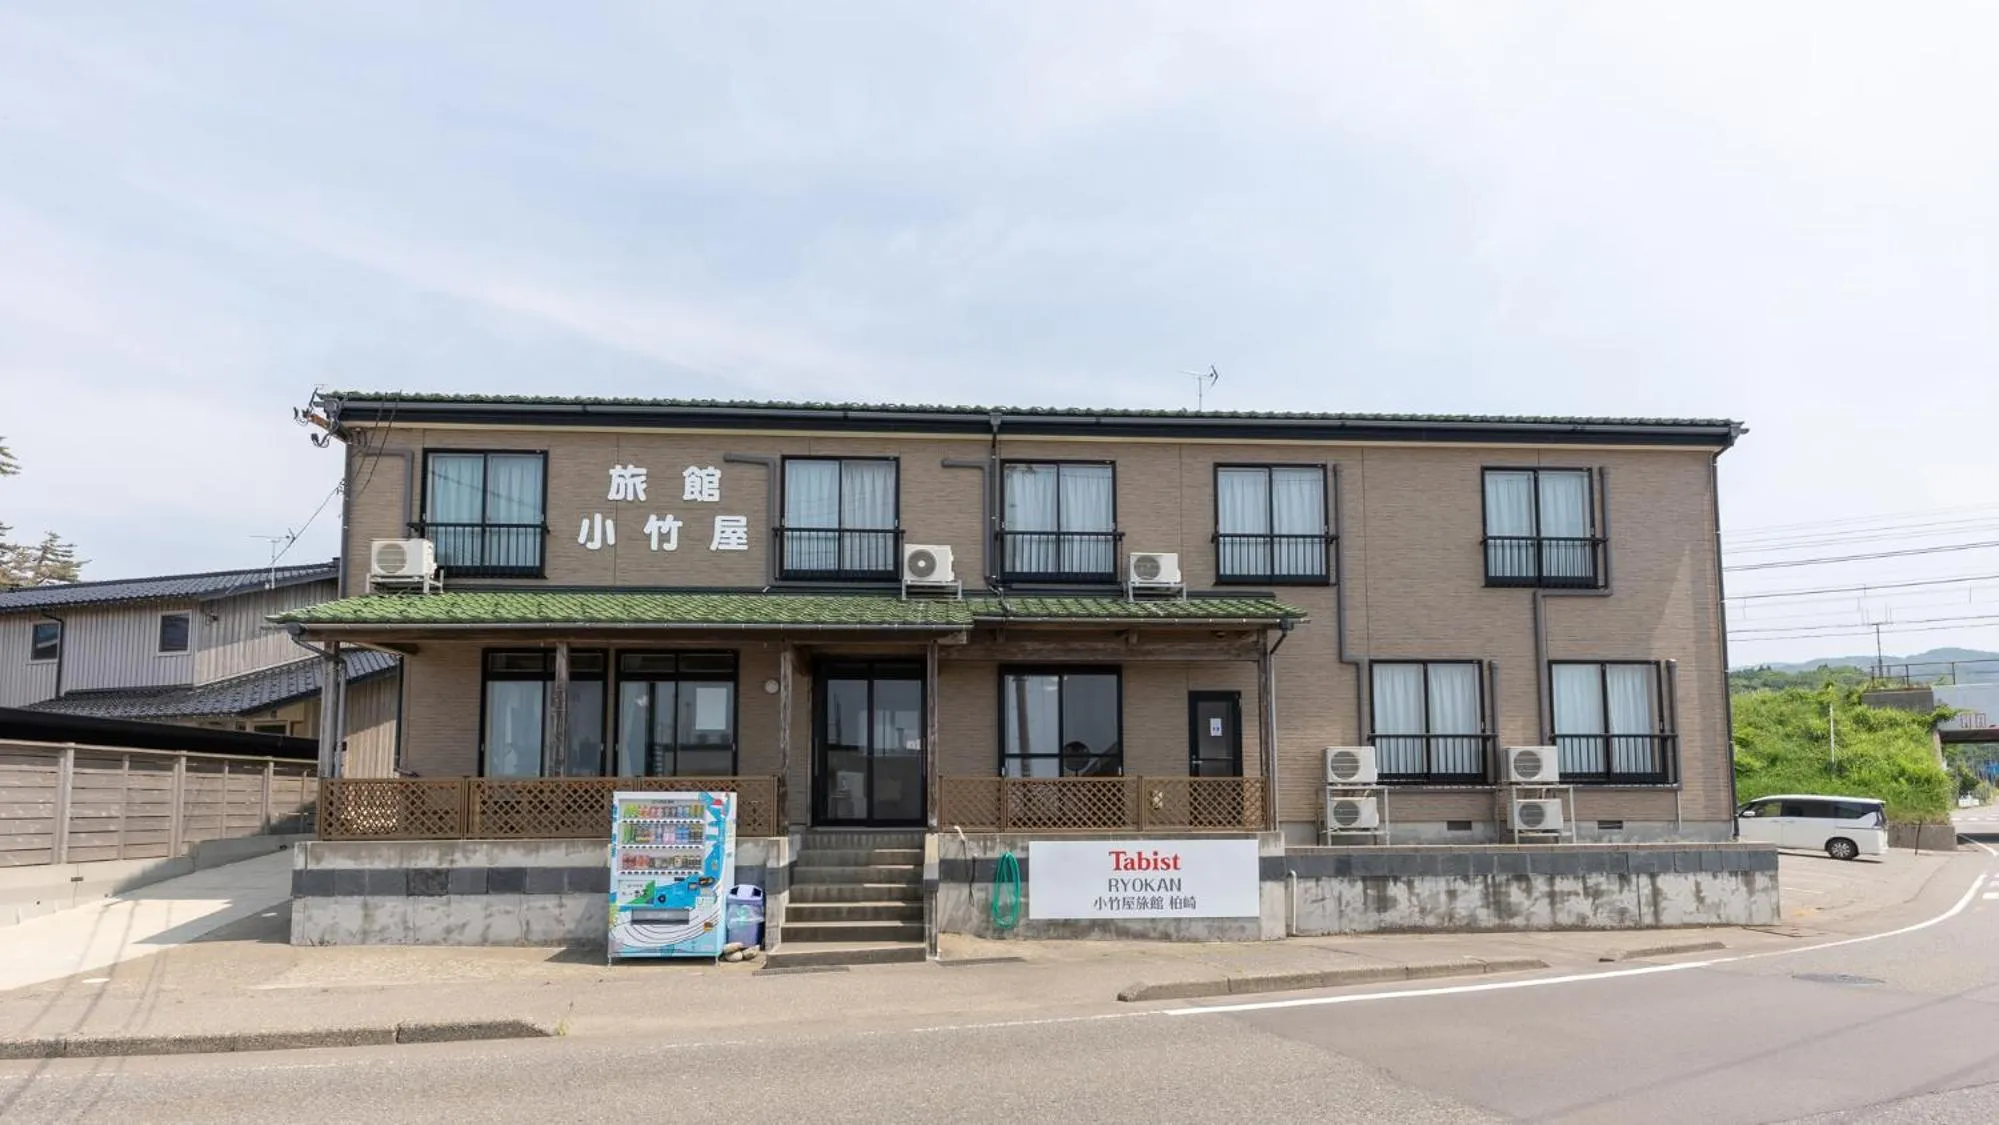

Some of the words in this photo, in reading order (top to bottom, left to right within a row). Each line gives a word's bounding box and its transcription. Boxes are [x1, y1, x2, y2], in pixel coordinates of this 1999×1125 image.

[608, 464, 721, 501] 旅館
[578, 513, 748, 550] 小竹屋
[1108, 851, 1181, 871] Tabist
[1108, 878, 1181, 892] RYOKAN
[1093, 896, 1164, 910] 小竹屋旅館
